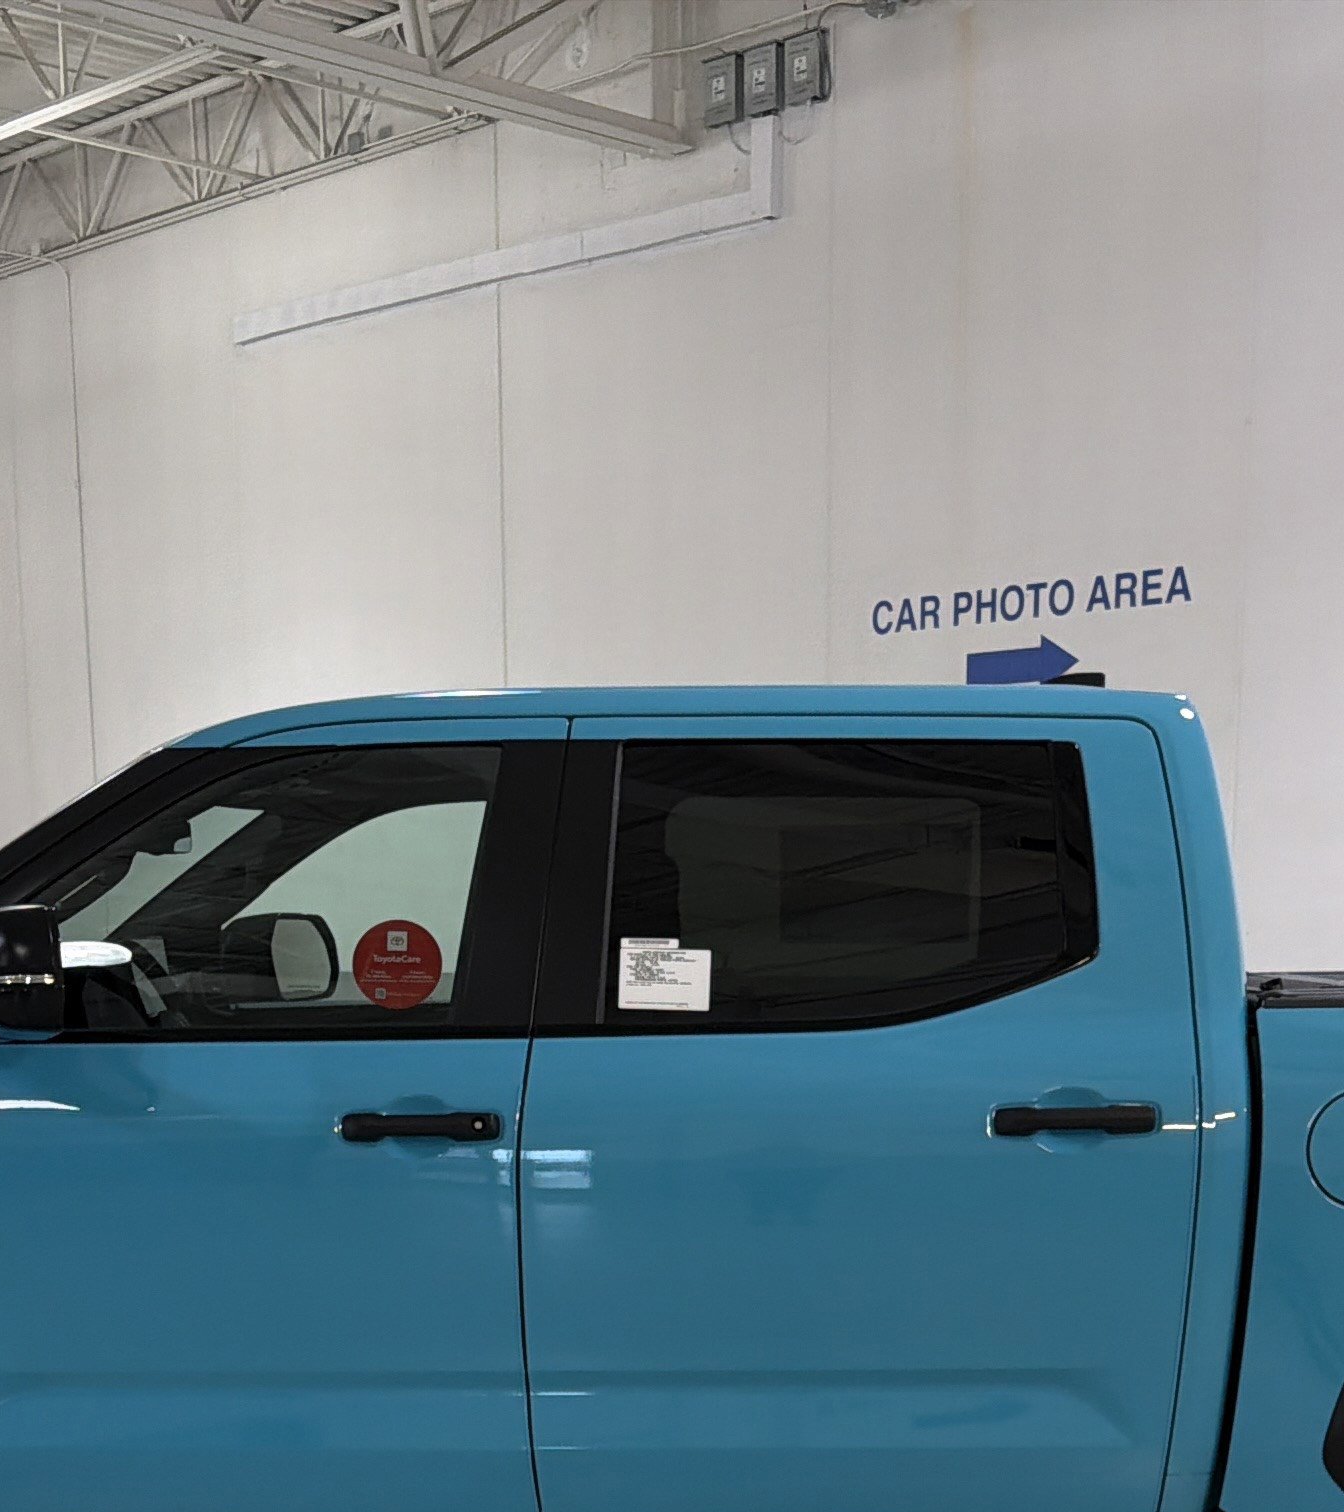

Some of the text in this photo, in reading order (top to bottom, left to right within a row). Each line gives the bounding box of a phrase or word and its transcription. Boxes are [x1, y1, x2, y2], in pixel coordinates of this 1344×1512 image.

[872, 565, 1193, 636] CAR PHOTO AREA
[371, 953, 422, 965] ToyotaCare
